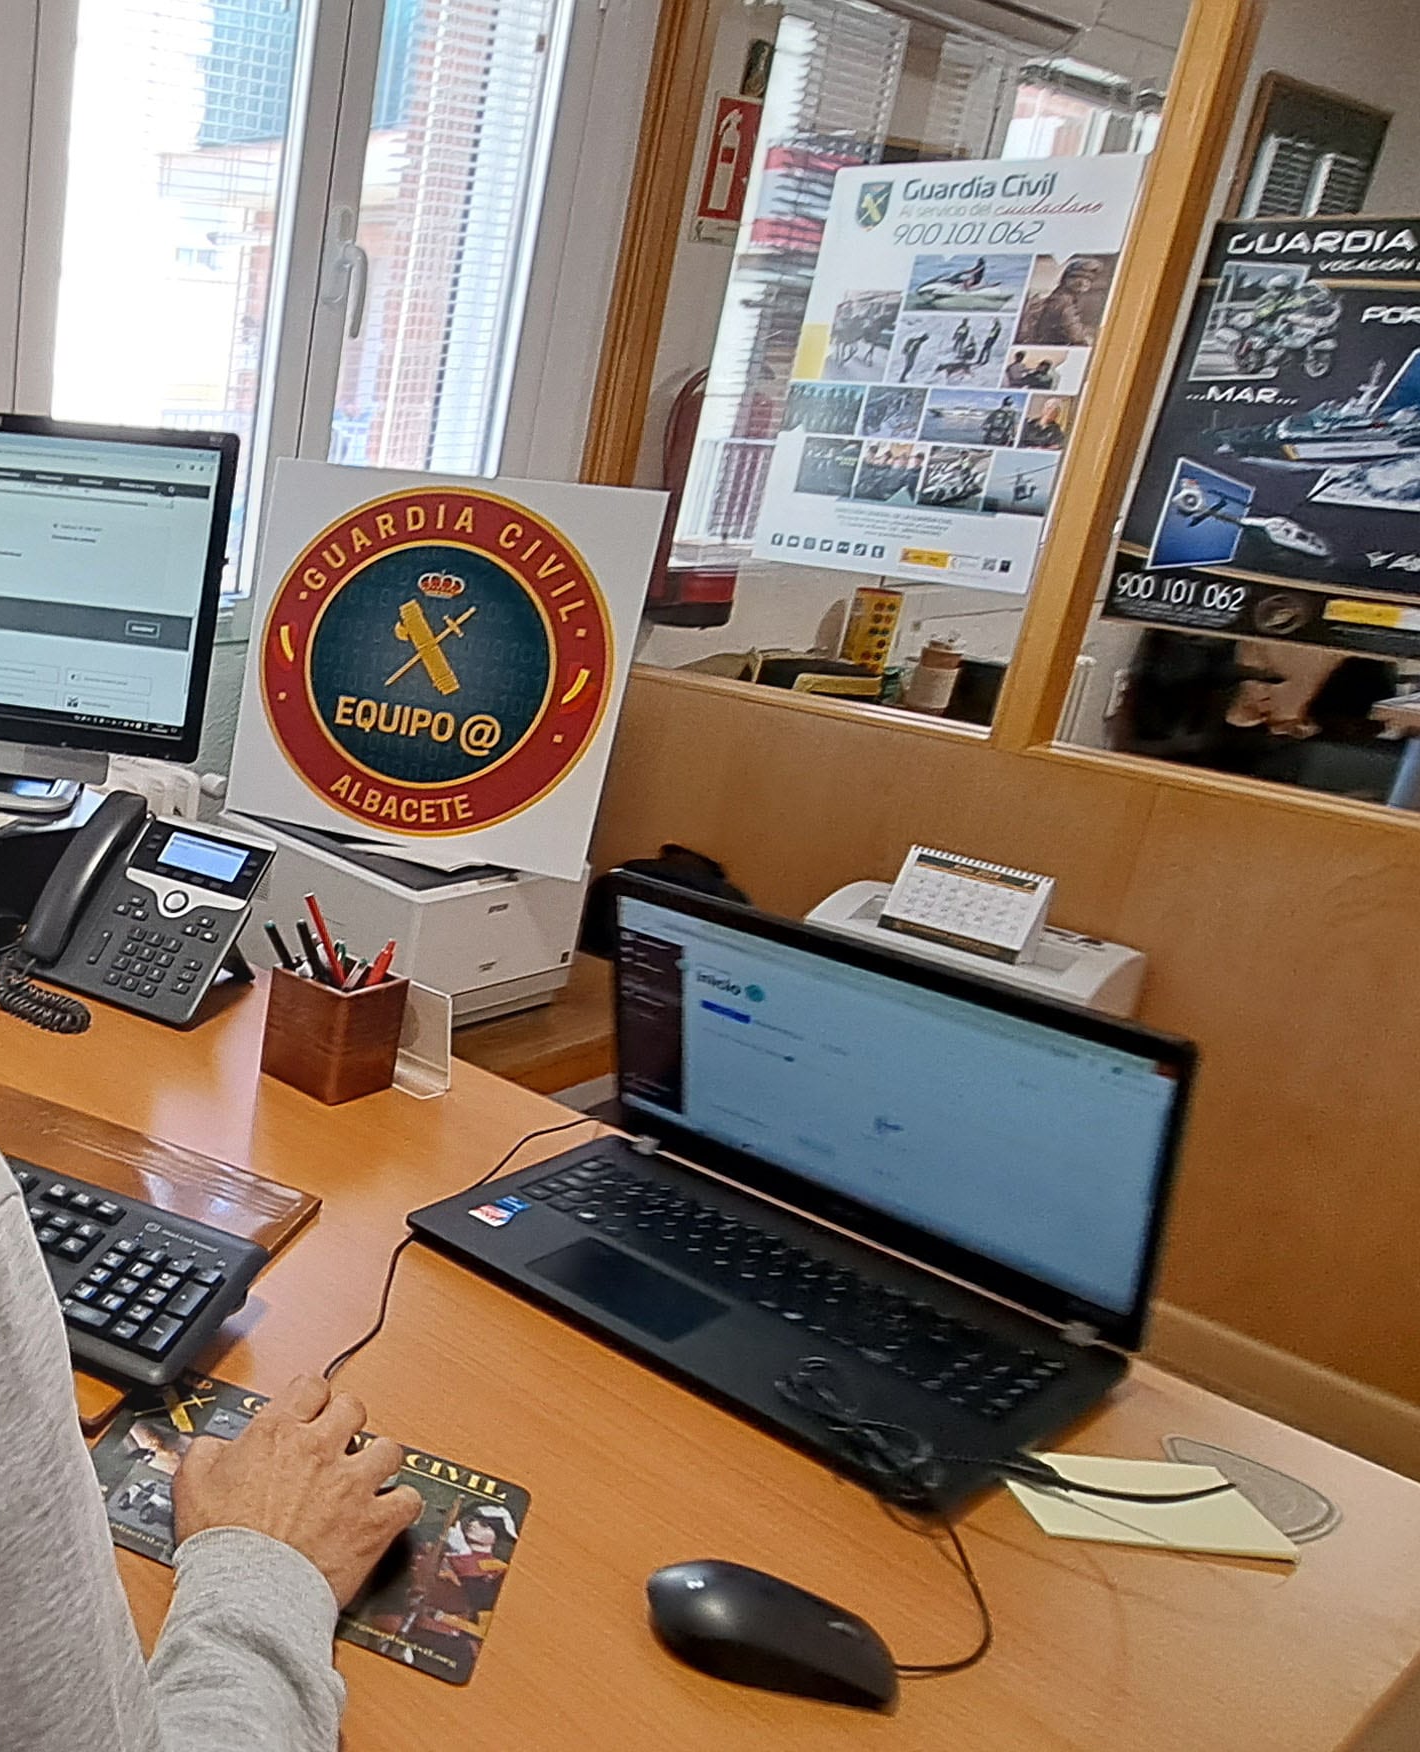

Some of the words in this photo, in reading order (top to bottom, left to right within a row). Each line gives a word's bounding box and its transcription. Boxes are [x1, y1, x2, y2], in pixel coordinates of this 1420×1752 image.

[903, 174, 997, 200] Guardia
[1001, 172, 1059, 198] Civil
[915, 202, 967, 218] servicio
[969, 201, 994, 216] del
[995, 193, 1103, 216] ciudadano
[893, 222, 942, 245] 900
[942, 221, 986, 245] 101
[988, 219, 1045, 245] 062
[1227, 228, 1418, 254] GUARDIA
[303, 503, 475, 593] GUARDIA
[498, 522, 587, 623] CIVIL
[1116, 571, 1156, 600] 900
[1161, 577, 1197, 605] 101
[1202, 582, 1247, 612] 062
[334, 695, 456, 743] EQUIPO
[459, 713, 502, 757] @
[330, 774, 474, 824] ALBACETE
[405, 1454, 508, 1500] CIVIL
